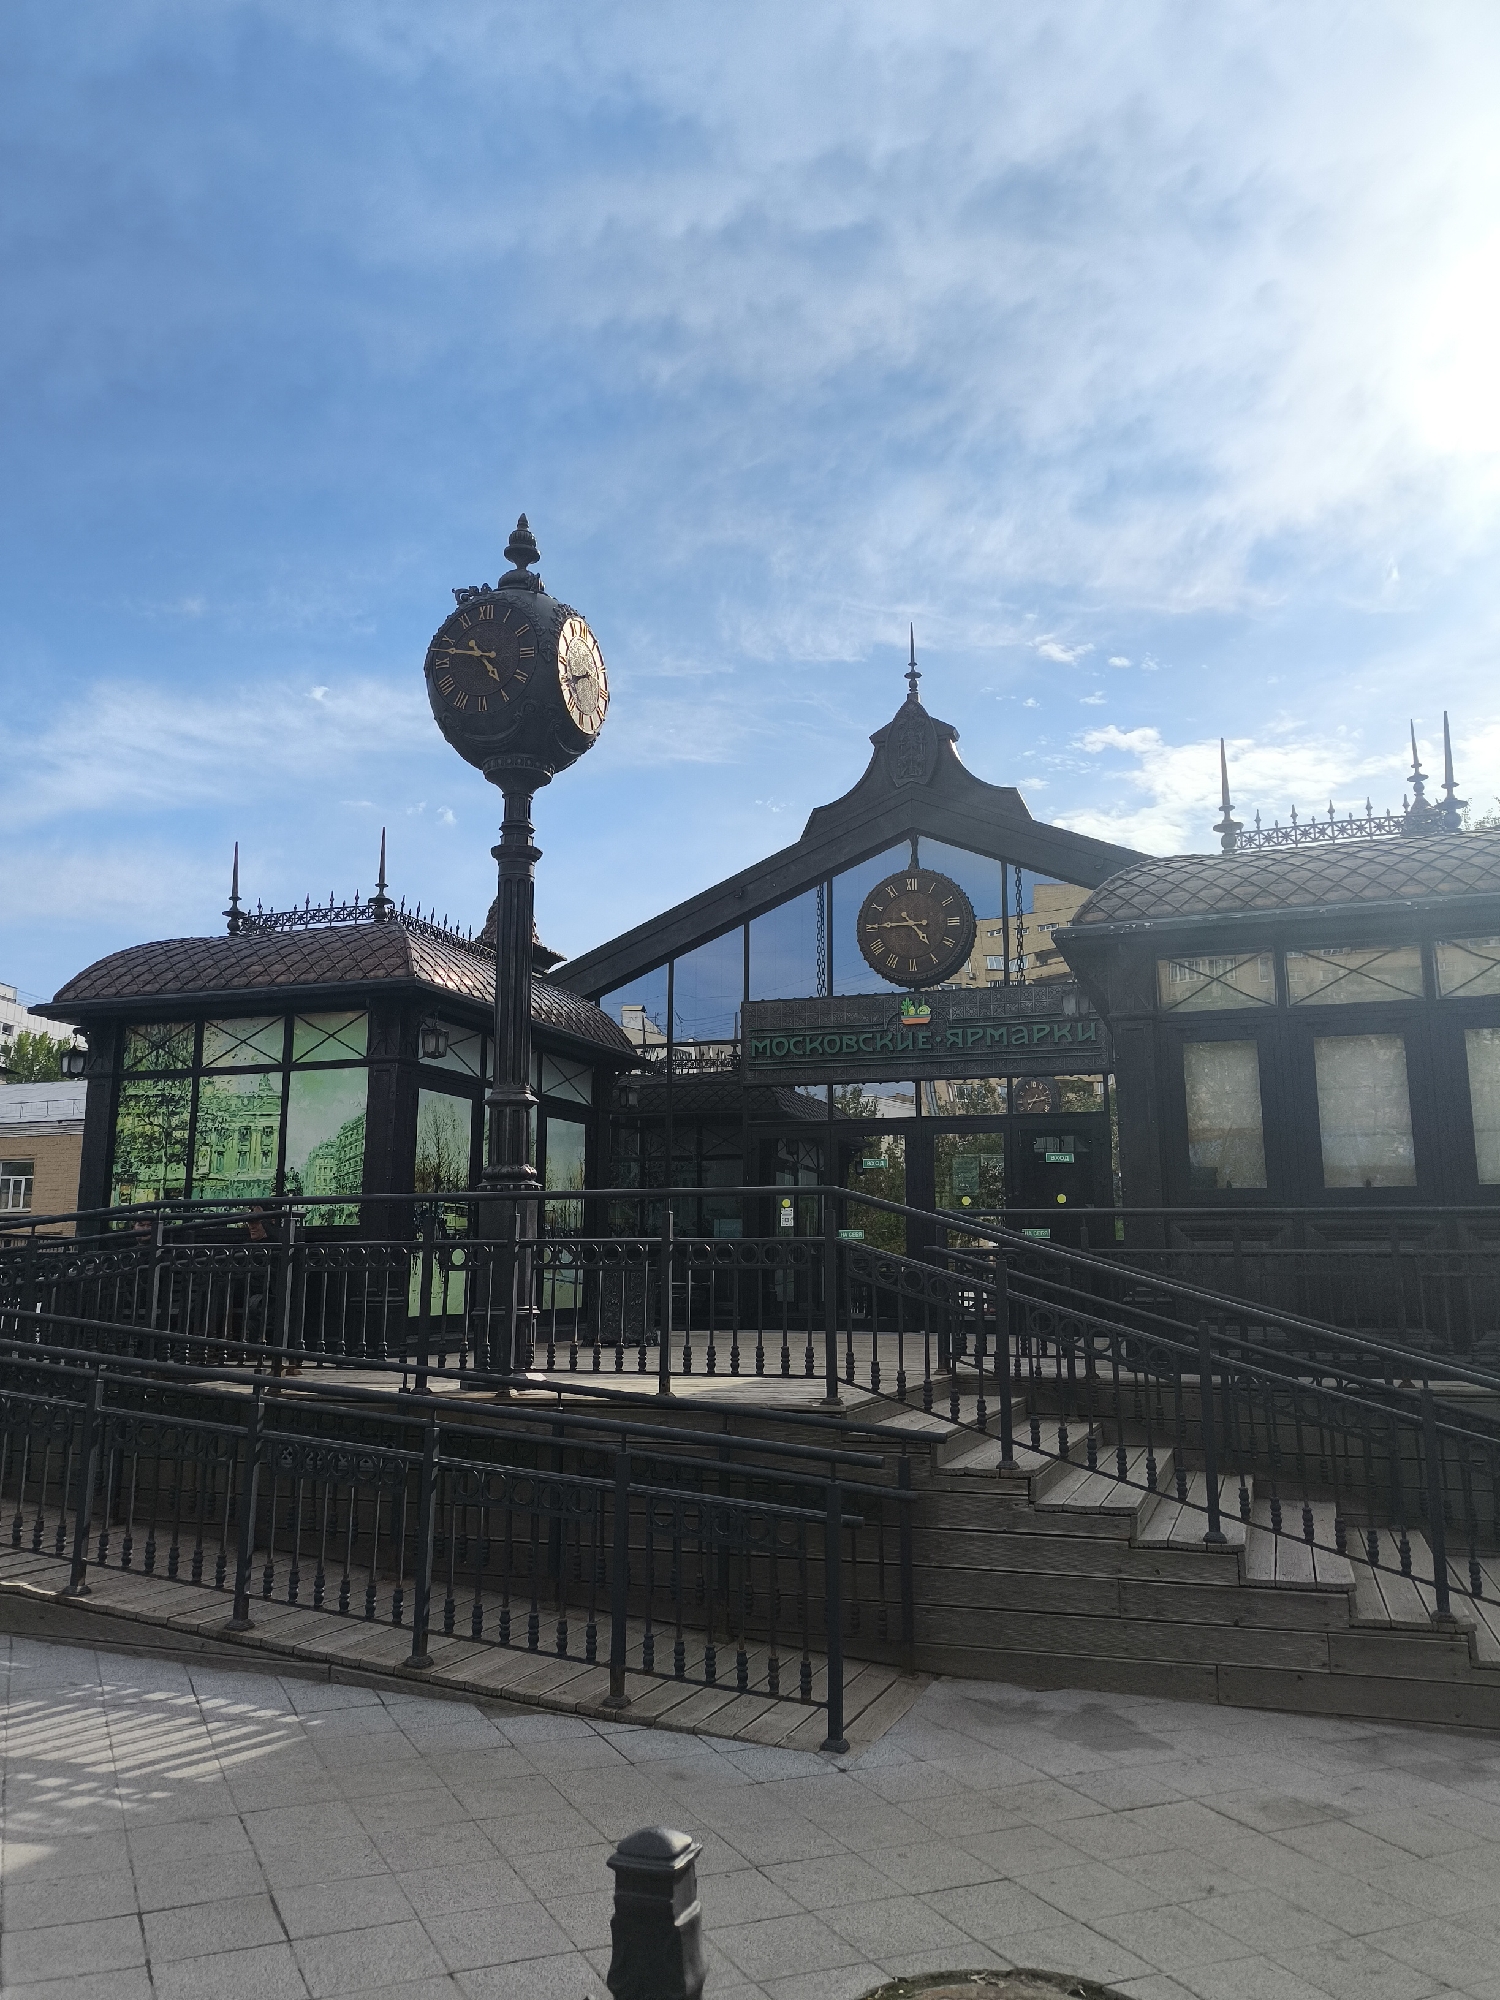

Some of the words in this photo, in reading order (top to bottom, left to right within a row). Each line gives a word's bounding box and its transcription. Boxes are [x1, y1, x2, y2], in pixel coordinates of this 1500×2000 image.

[479, 605, 494, 620] XII
[906, 878, 917, 891] XII
[751, 1031, 932, 1057] МОСКОВСКИЕ
[945, 1022, 1097, 1048] ЯРМАРКИ
